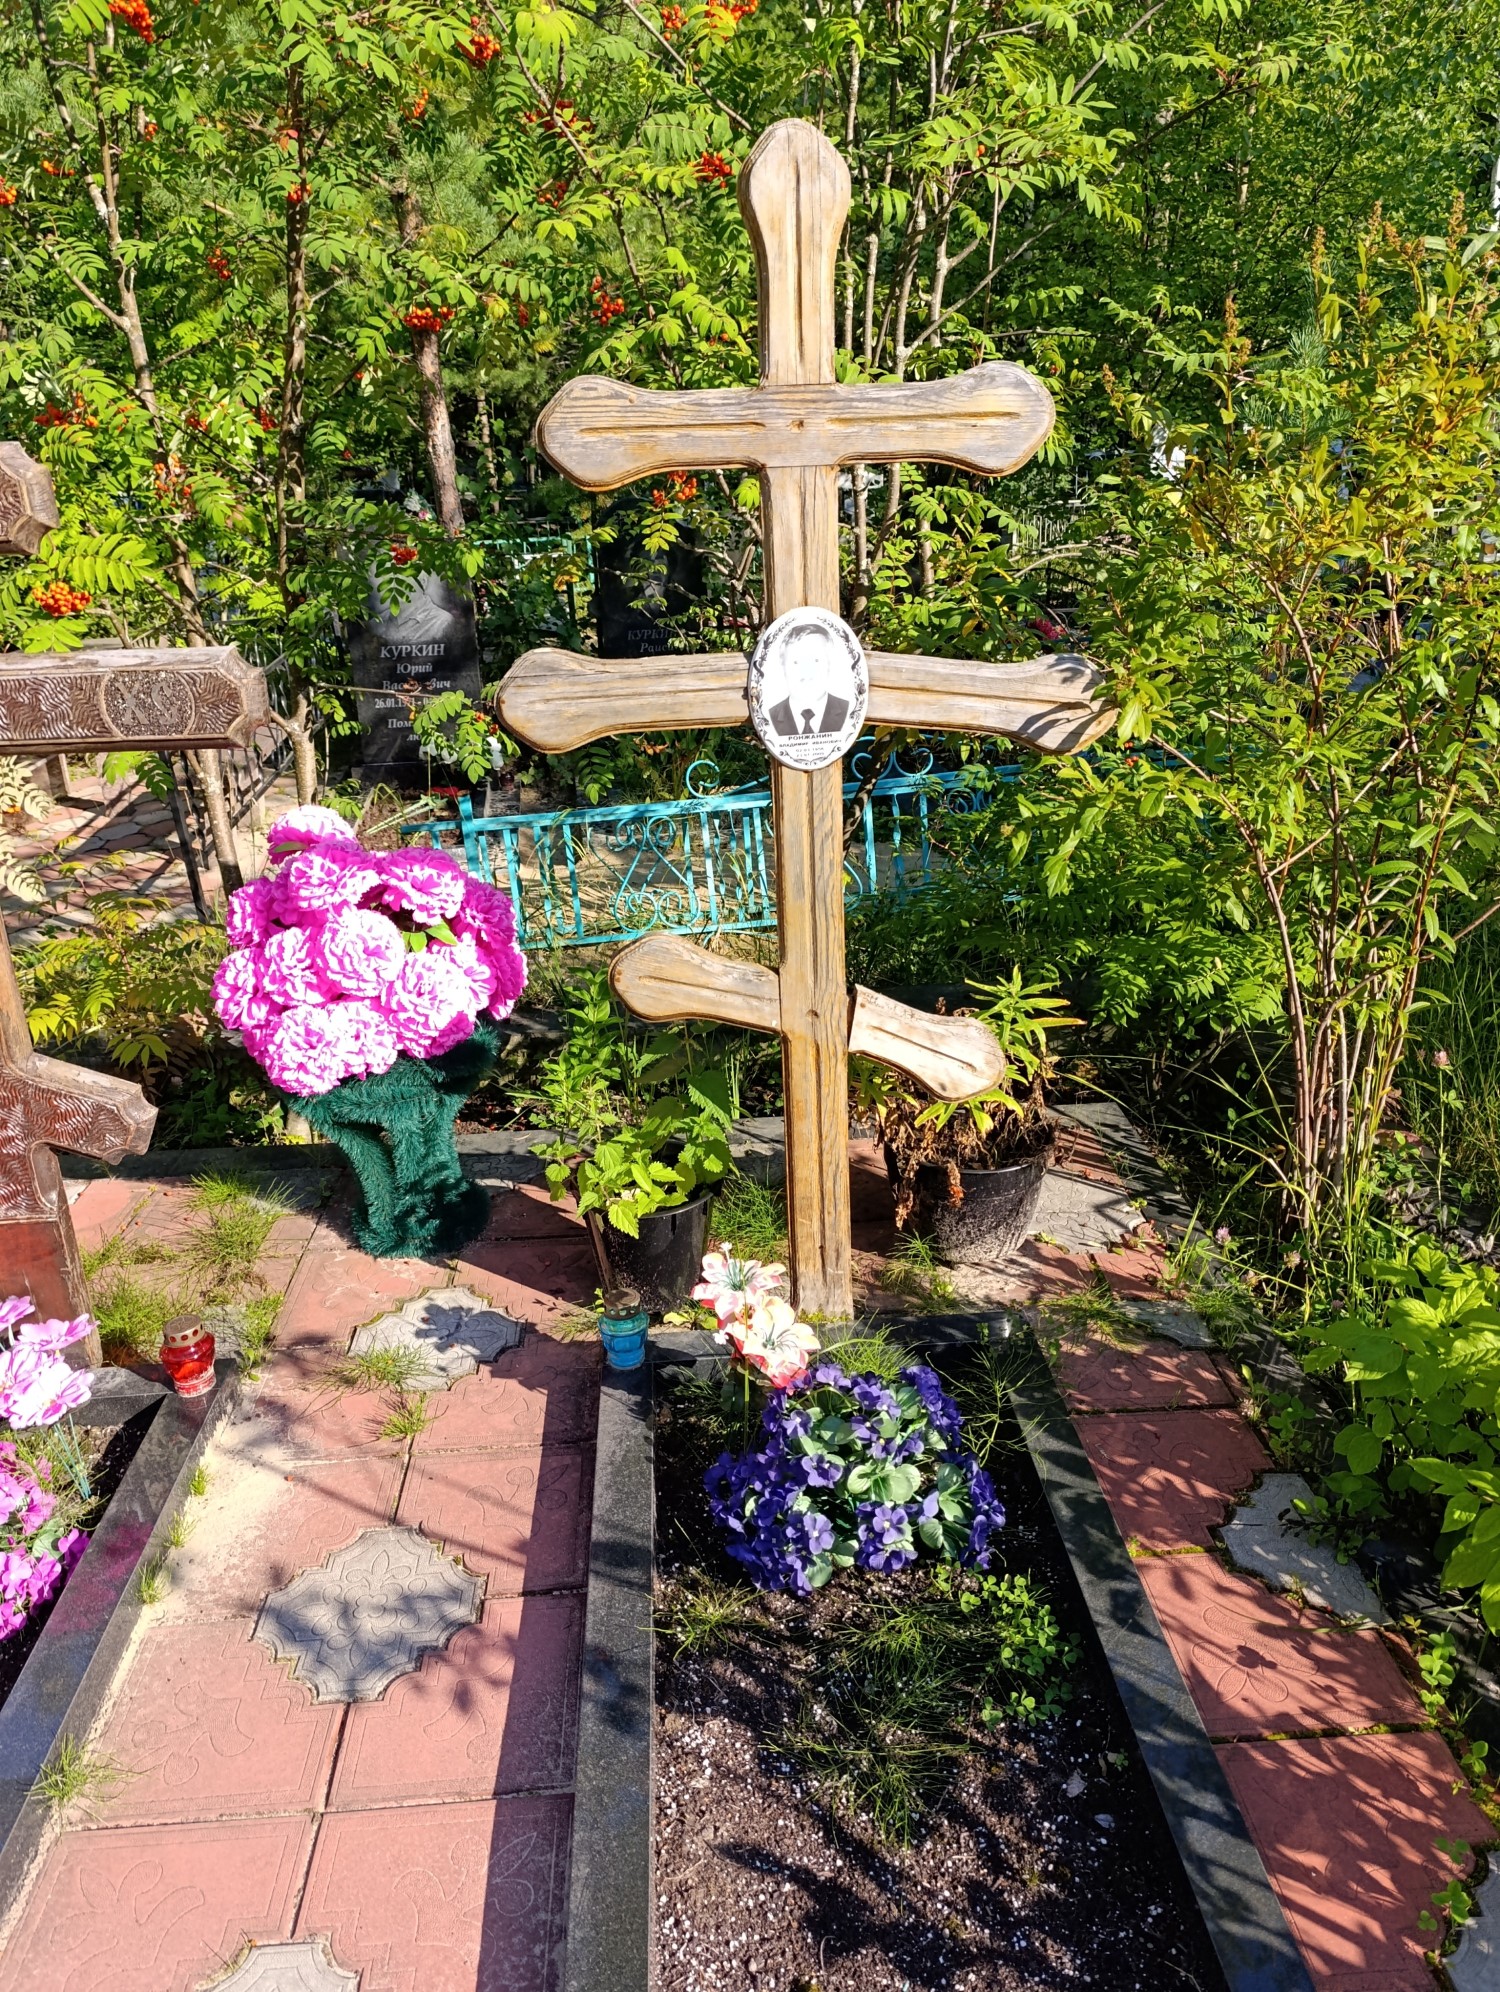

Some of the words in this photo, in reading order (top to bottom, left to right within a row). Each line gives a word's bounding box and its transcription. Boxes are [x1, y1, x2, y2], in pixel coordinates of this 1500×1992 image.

[380, 644, 445, 659] КУРКИН
[396, 662, 433, 675] Юрий
[787, 733, 833, 741] РОНЖАНИН
